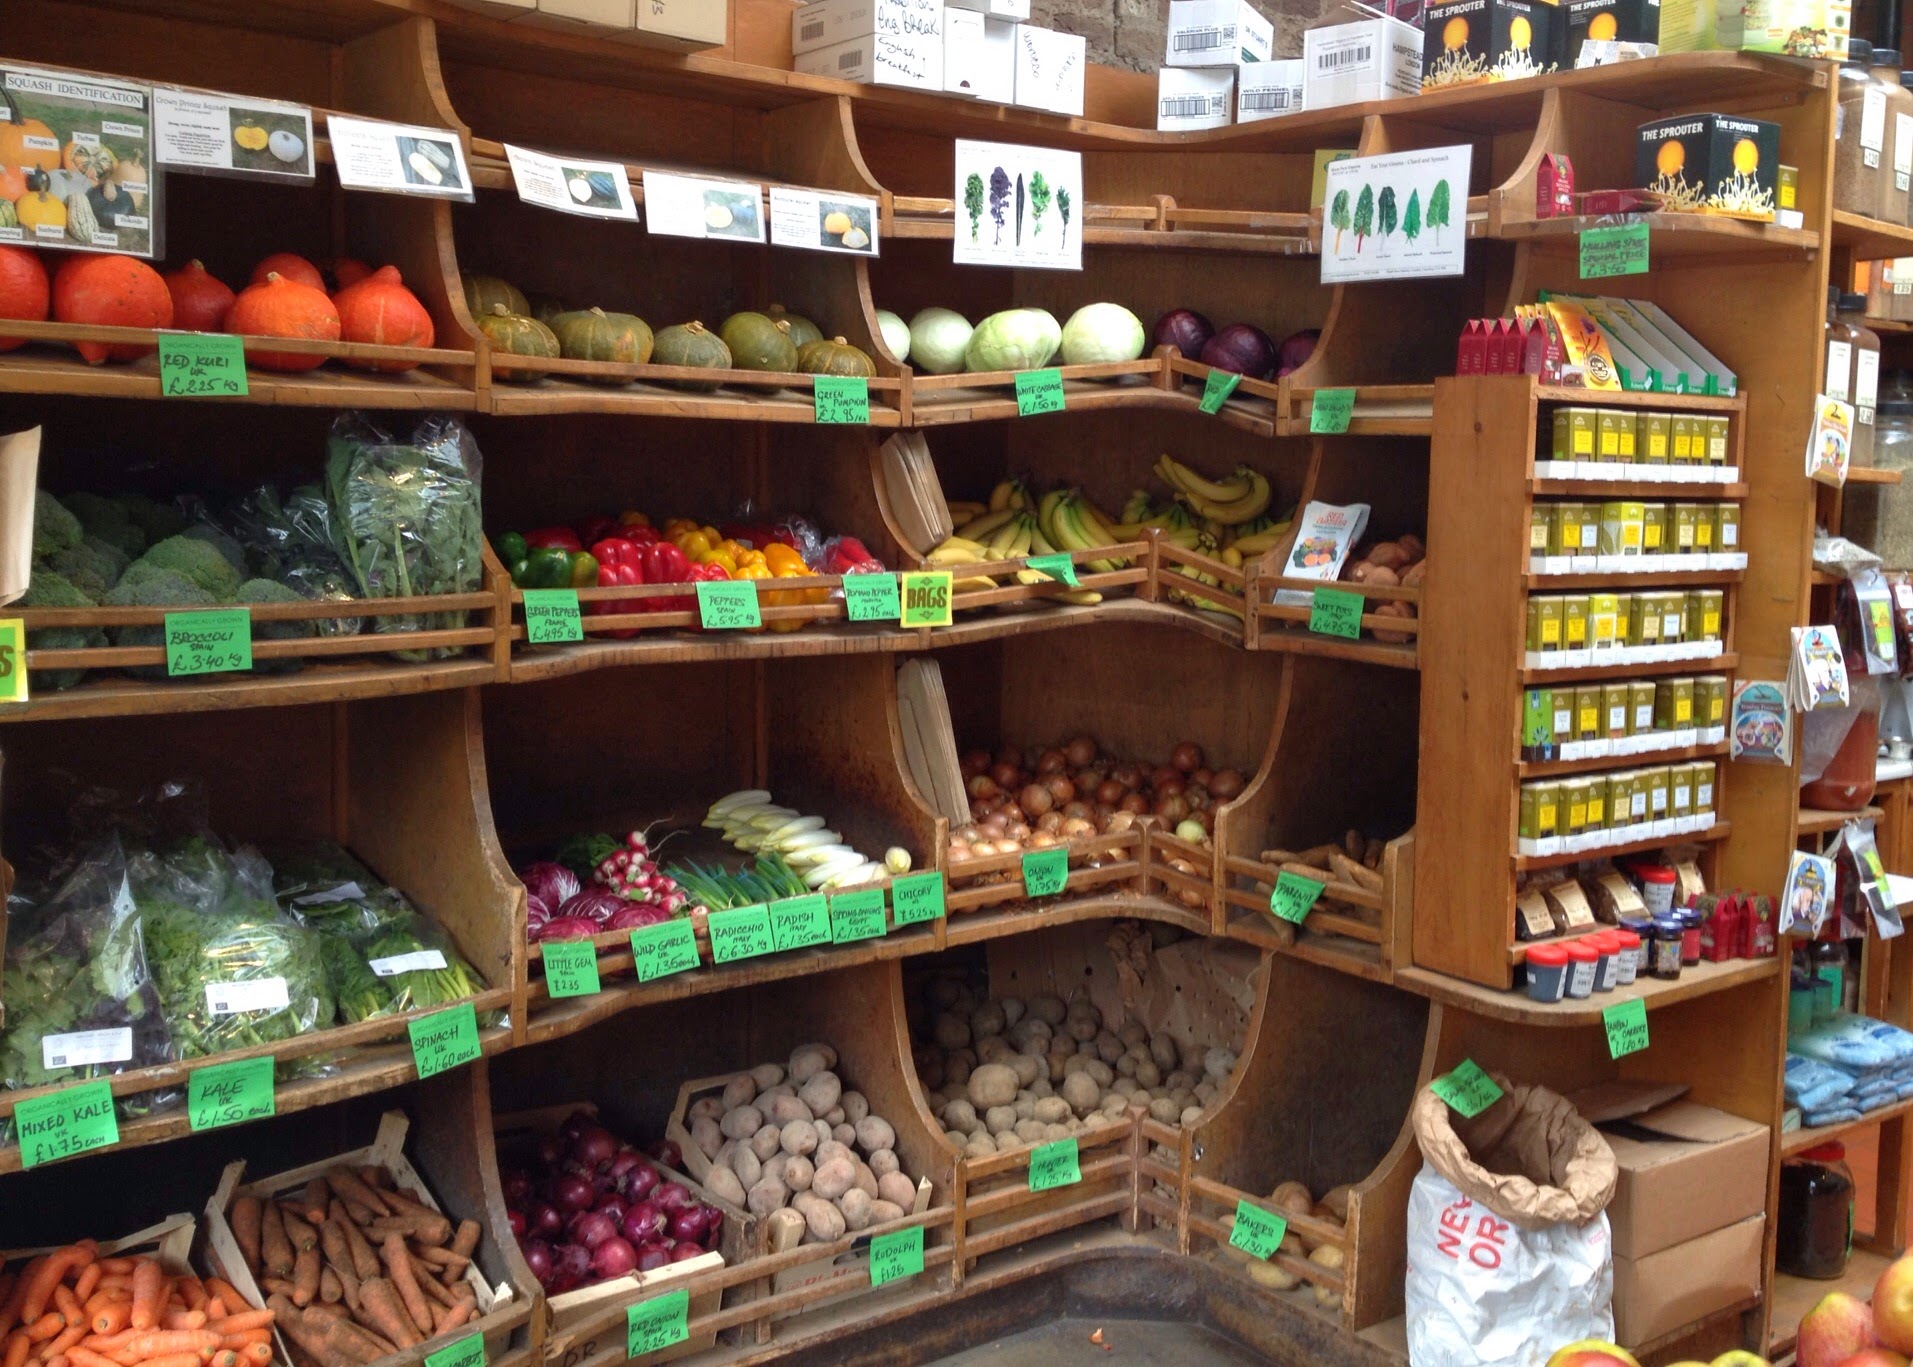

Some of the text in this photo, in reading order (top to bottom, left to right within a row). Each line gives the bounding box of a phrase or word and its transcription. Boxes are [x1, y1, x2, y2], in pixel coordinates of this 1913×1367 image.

[1430, 0, 1486, 20] THE SPROUTER
[1570, 4, 1582, 12] THE
[7, 76, 142, 105] SQUASH IDENTIFICATION
[1642, 122, 1704, 142] THE SPROUTER
[1716, 119, 1760, 134] THE SPROUTER
[28, 137, 54, 147] Pumpkin
[163, 353, 229, 369] RED KURI
[817, 391, 844, 402] GREEN
[708, 595, 746, 607] PEPPERS
[906, 586, 947, 610] BAGS
[170, 631, 234, 645] BROCCOLI
[190, 643, 215, 652] SPAIN
[898, 884, 933, 901] CHICORY
[776, 911, 814, 929] RADISH
[714, 922, 765, 940] RADICCHIO
[633, 934, 691, 958] WILD GARLIC
[547, 957, 593, 970] LITTLE GEM
[414, 1024, 459, 1053] SPINACH
[201, 1078, 248, 1102] KALE
[22, 1100, 113, 1138] MIXED KALE
[35, 1135, 83, 1164] £1.75
[874, 1239, 916, 1262] RUDOLPH
